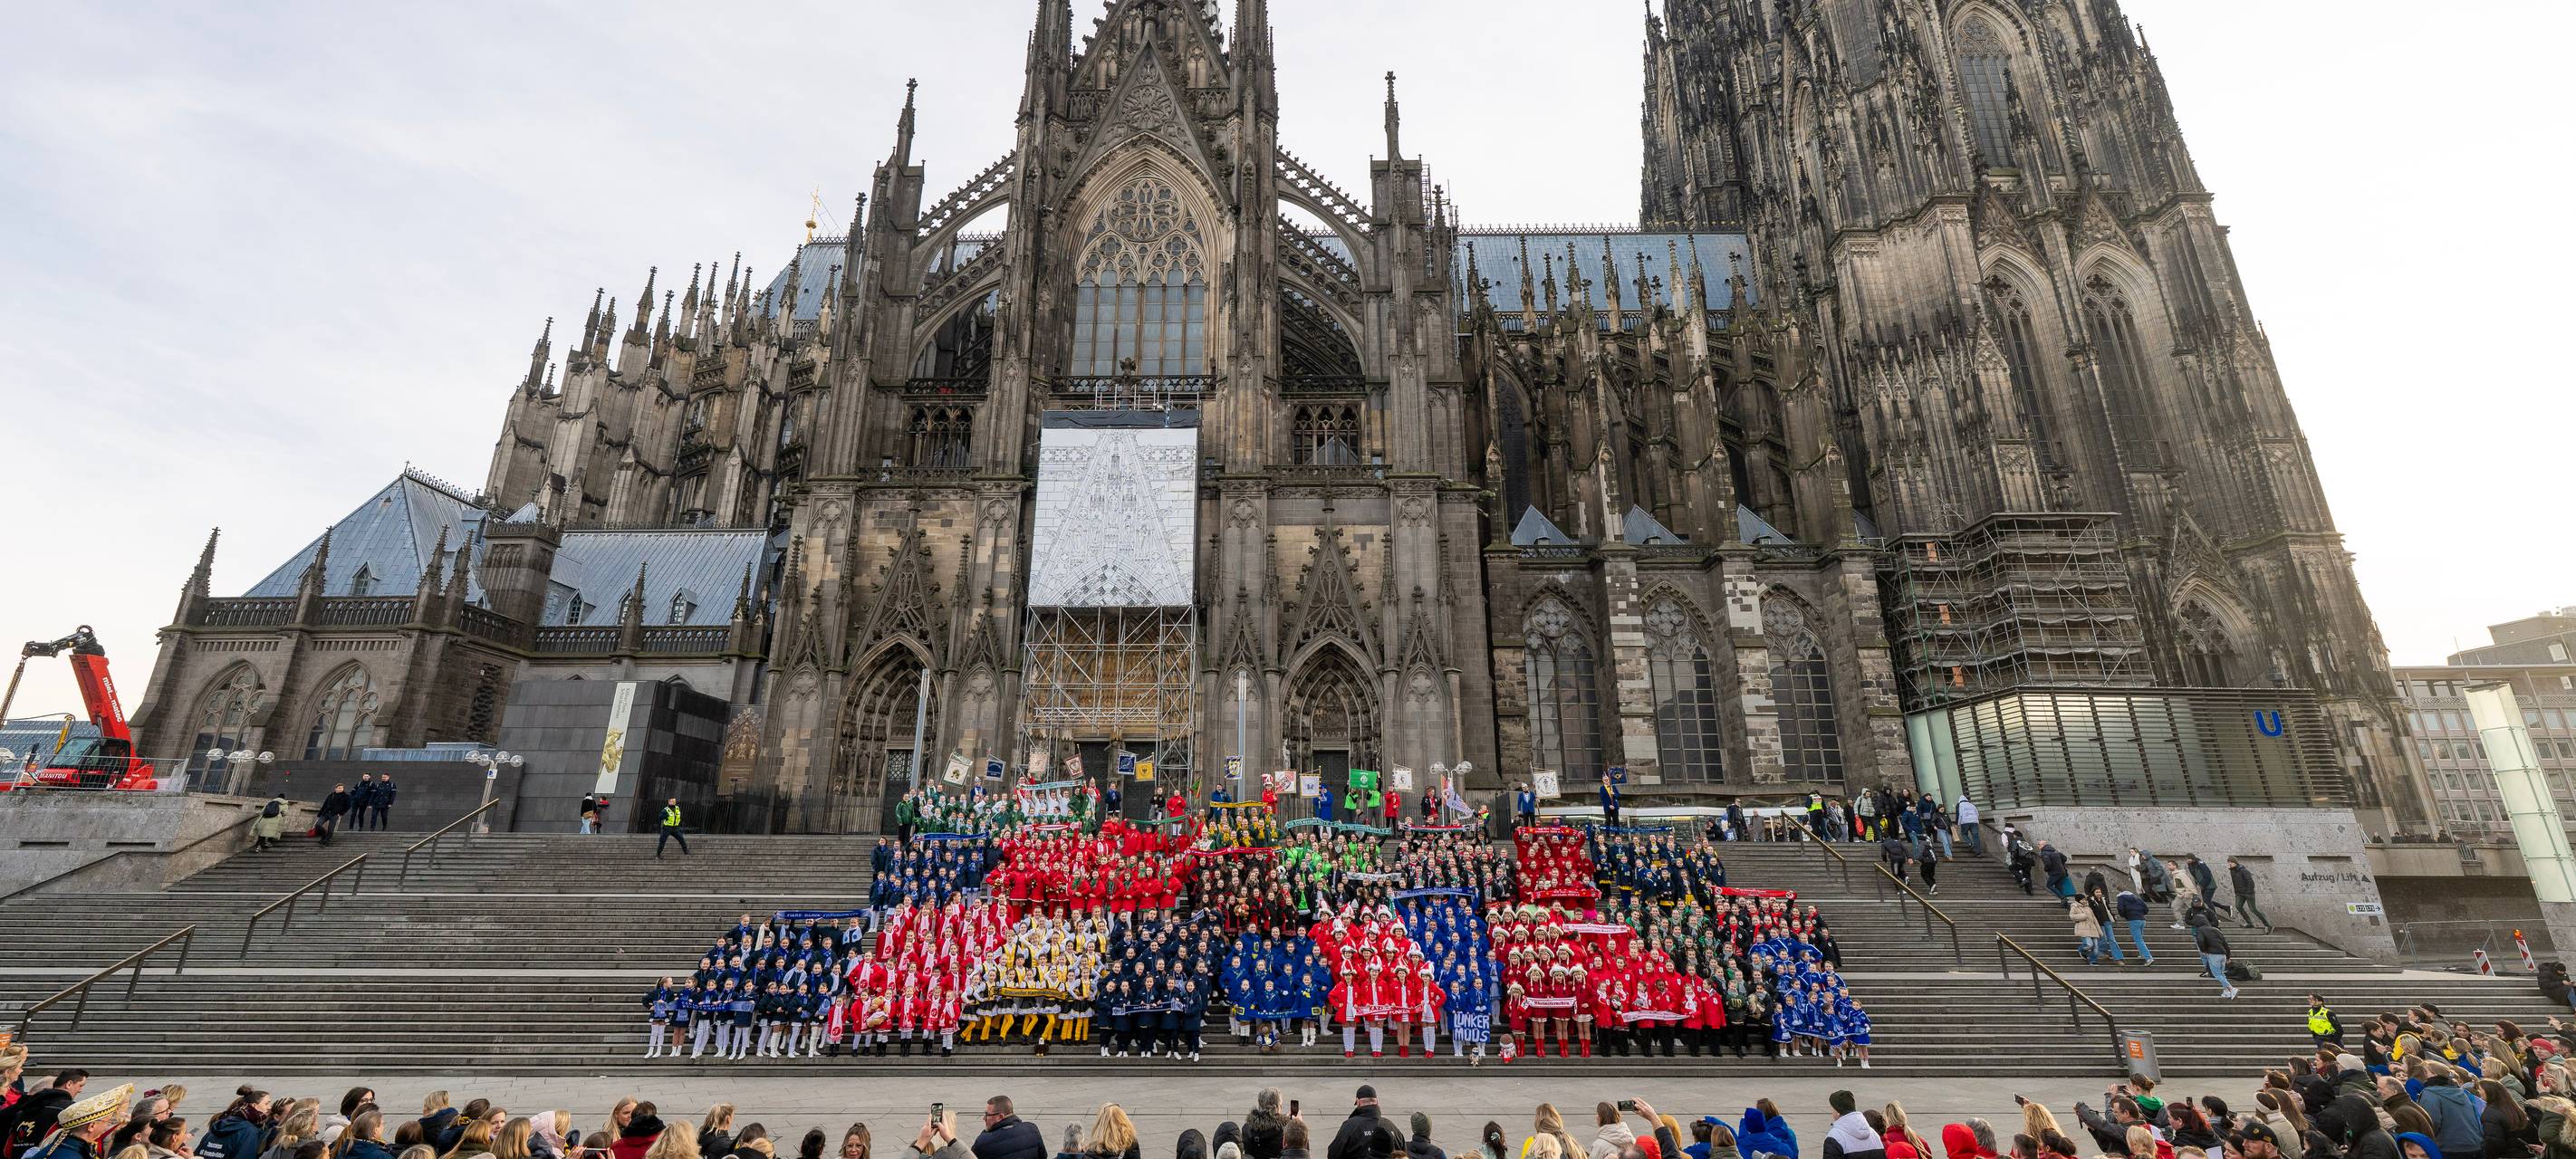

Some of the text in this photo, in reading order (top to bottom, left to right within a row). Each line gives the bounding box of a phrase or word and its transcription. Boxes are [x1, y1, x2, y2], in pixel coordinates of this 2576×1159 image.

[2254, 710, 2283, 738] U
[2302, 872, 2336, 884] Aufzug
[2341, 873, 2359, 882] Lift
